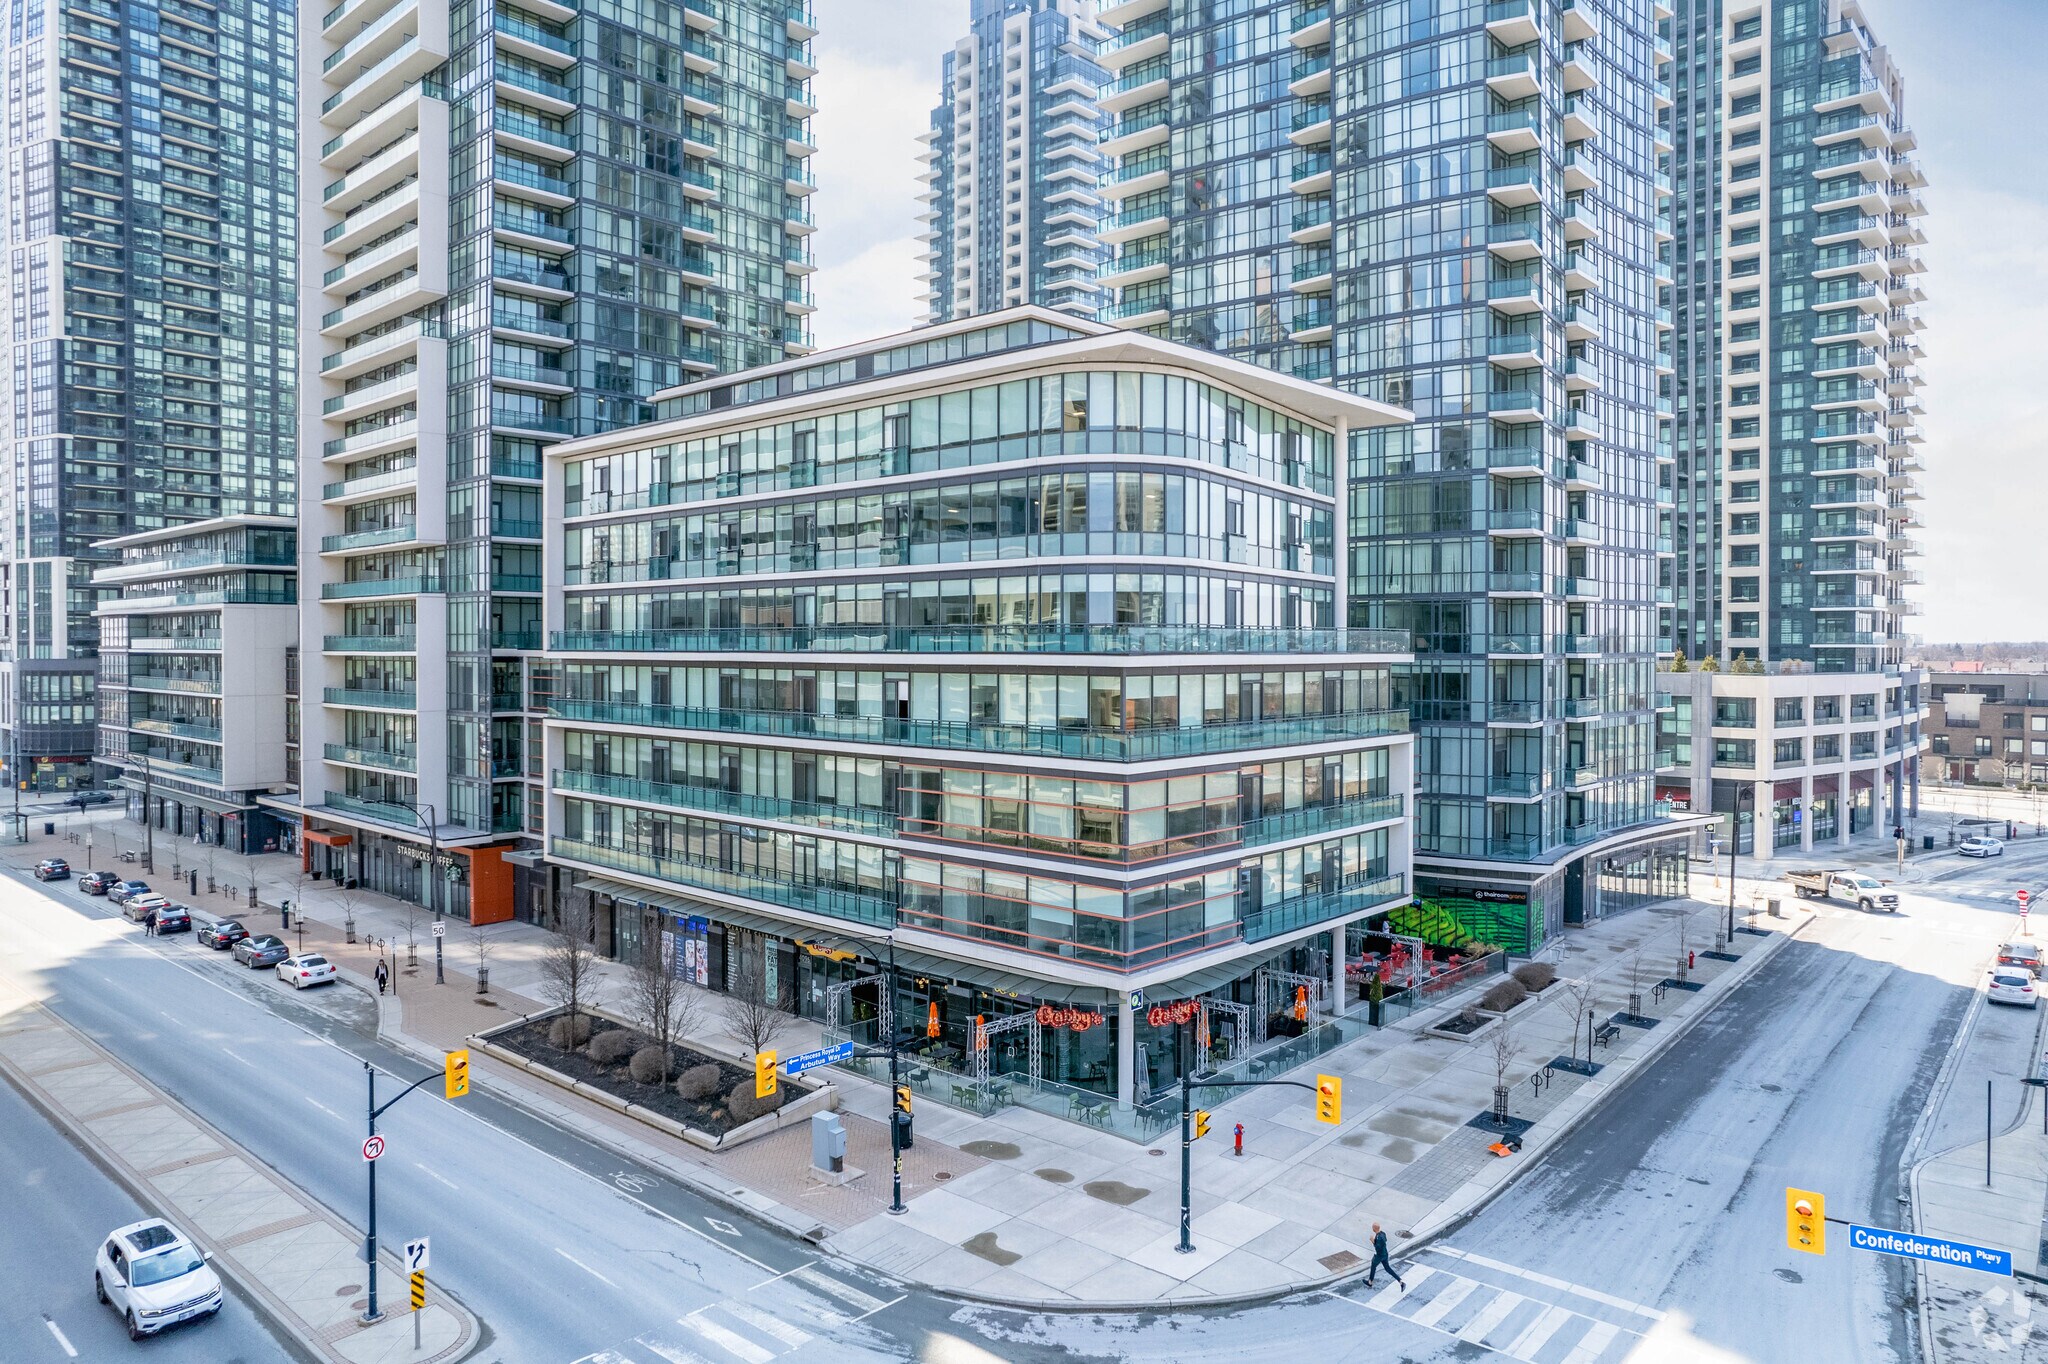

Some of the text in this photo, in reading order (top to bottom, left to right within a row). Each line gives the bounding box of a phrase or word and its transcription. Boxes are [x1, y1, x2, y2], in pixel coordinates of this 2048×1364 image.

[397, 845, 453, 867] STARBUCKS FFEE
[433, 926, 444, 935] 50
[768, 955, 777, 964] FAT
[1036, 1004, 1103, 1032] Gabby's
[1148, 1000, 1200, 1027] Gabby's
[800, 1051, 821, 1061] Princess
[821, 1046, 835, 1056] Royal
[800, 1053, 841, 1070] Arbutus Way
[1855, 1229, 2002, 1264] Confederation Pkwy
